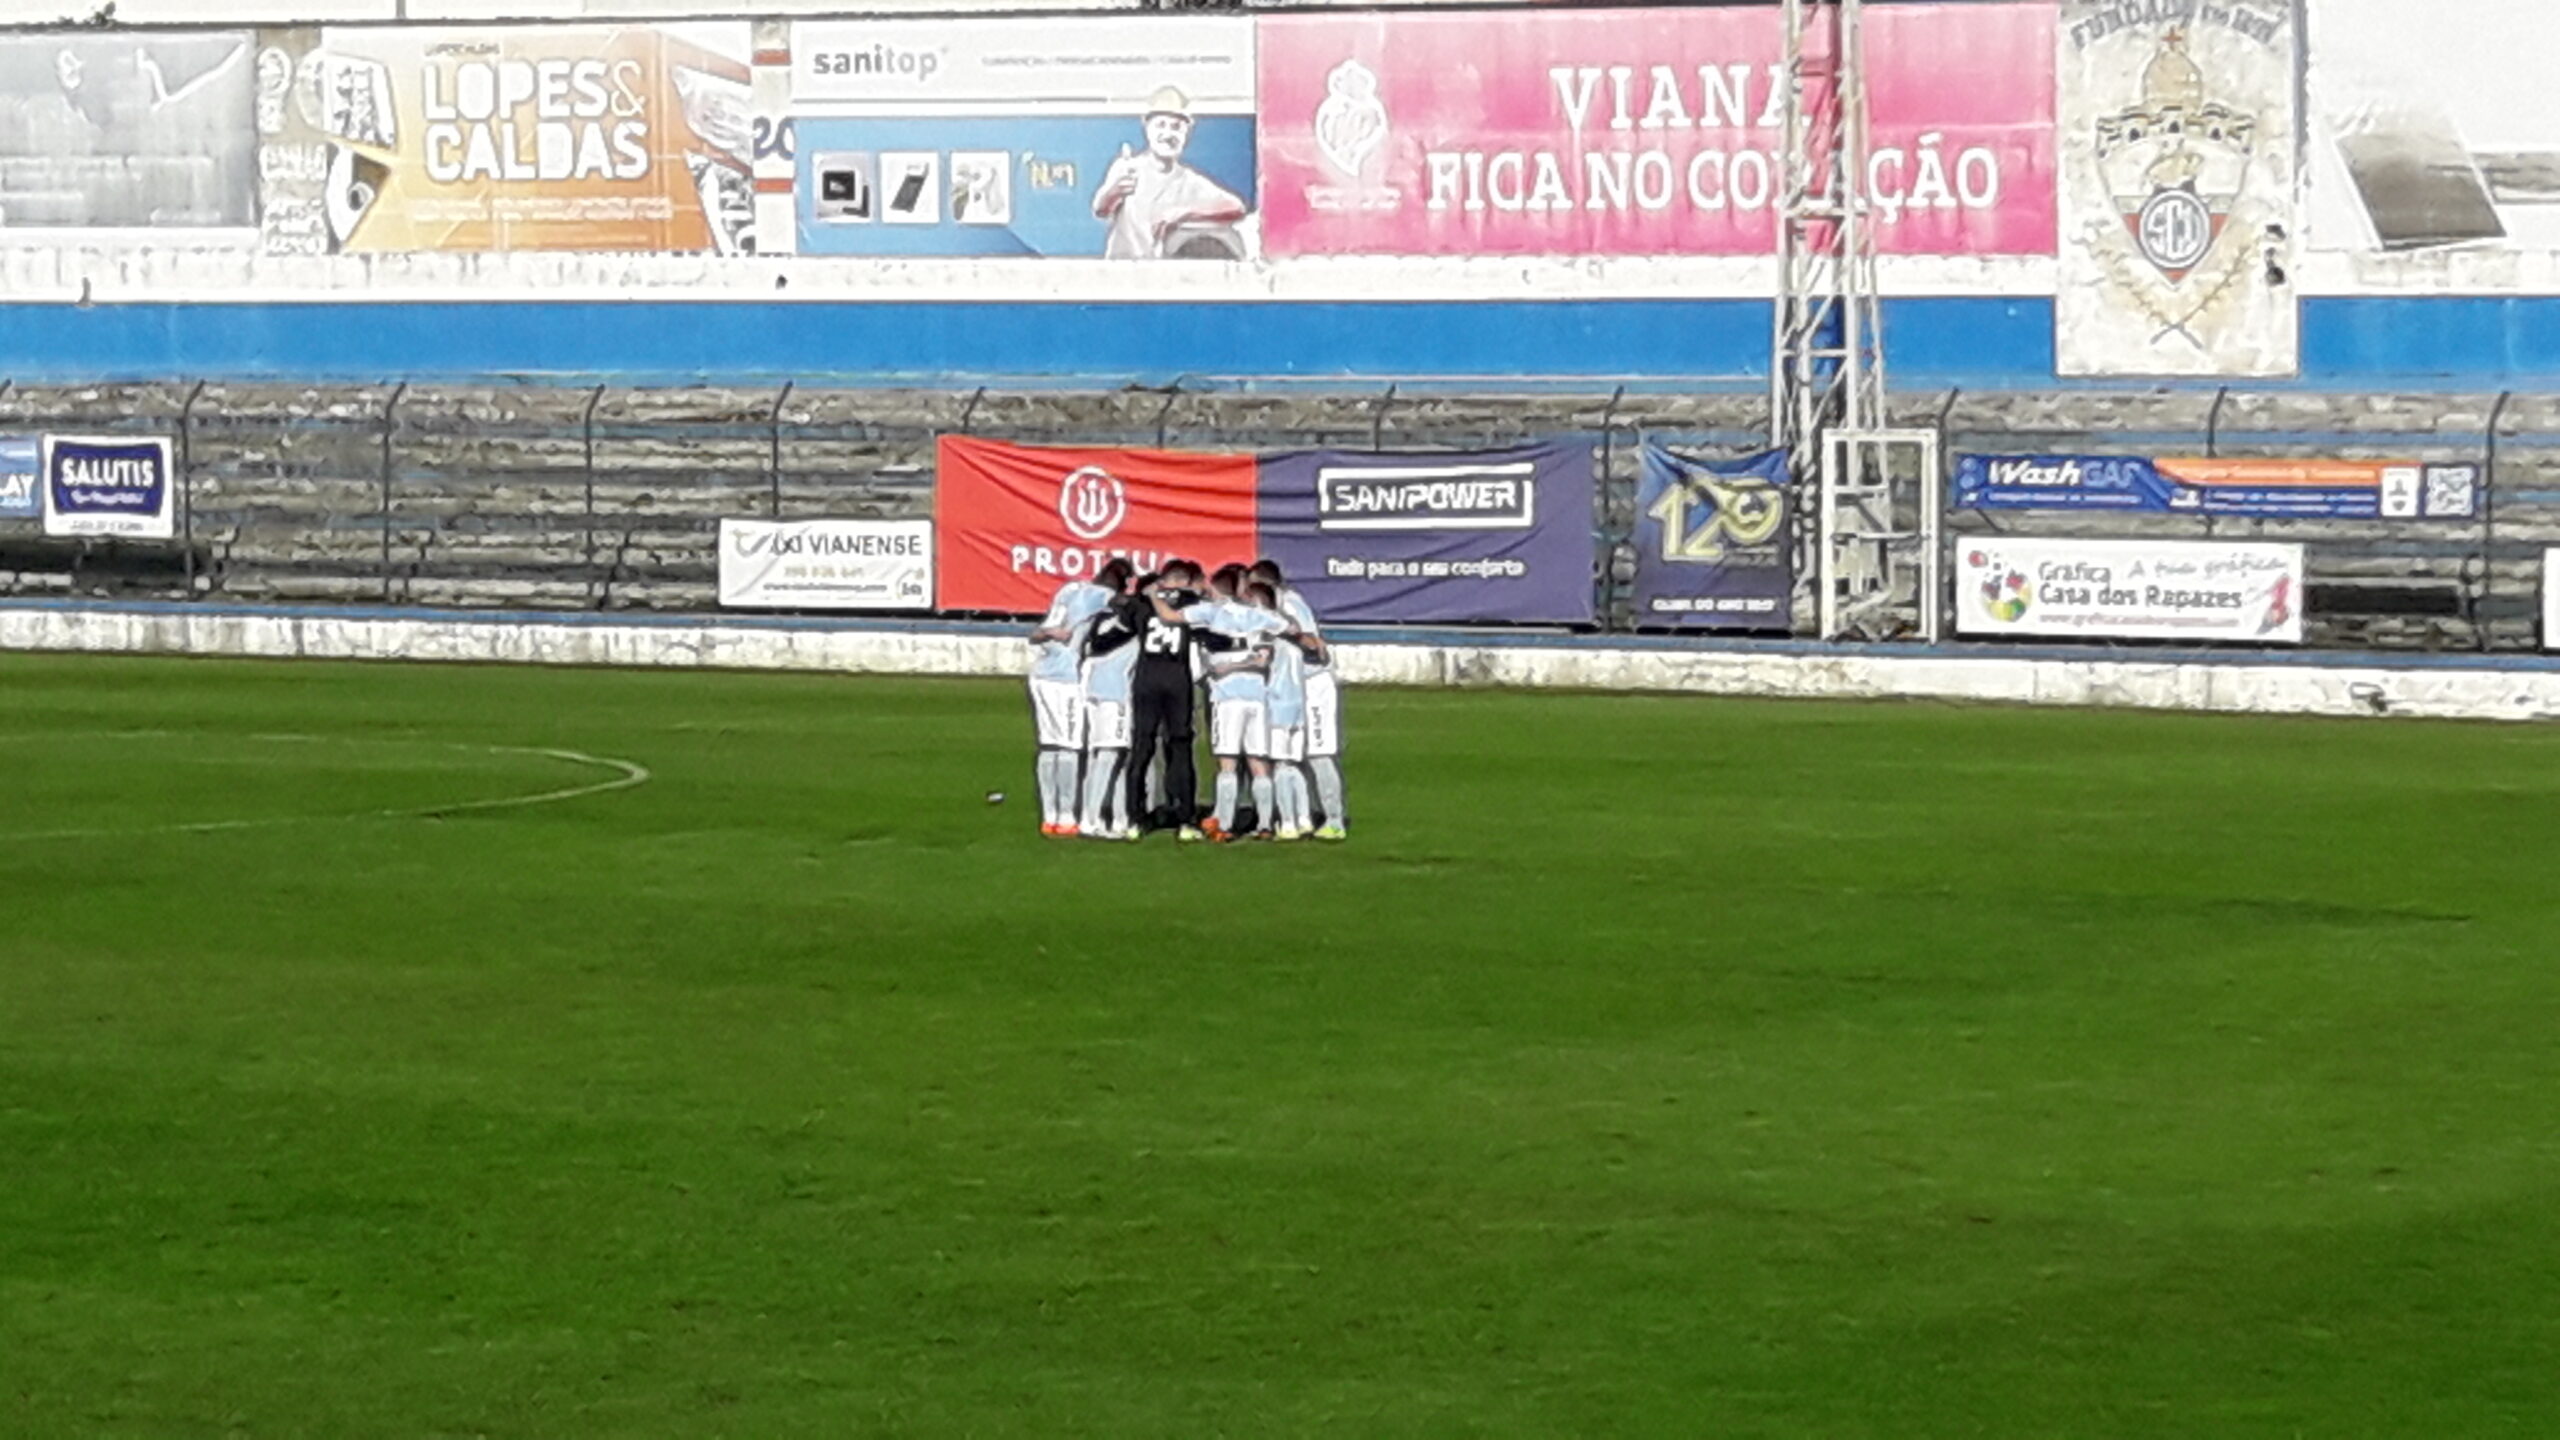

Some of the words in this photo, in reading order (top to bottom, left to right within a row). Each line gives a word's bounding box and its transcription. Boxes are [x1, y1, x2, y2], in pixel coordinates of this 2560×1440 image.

[812, 44, 939, 81] sanitop
[424, 121, 650, 182] CALDAS
[1425, 151, 1574, 210] FICA
[1583, 149, 1673, 210] NO
[61, 457, 155, 487] SALUTIS
[1334, 479, 1518, 513] SANIPOWER
[808, 532, 923, 556] VIANENSE
[1011, 545, 1179, 577] PROTU
[2038, 583, 2092, 605] Casa
[2097, 582, 2138, 605] dos
[2145, 584, 2243, 612] Rapazes
[1145, 618, 1181, 653] 24
